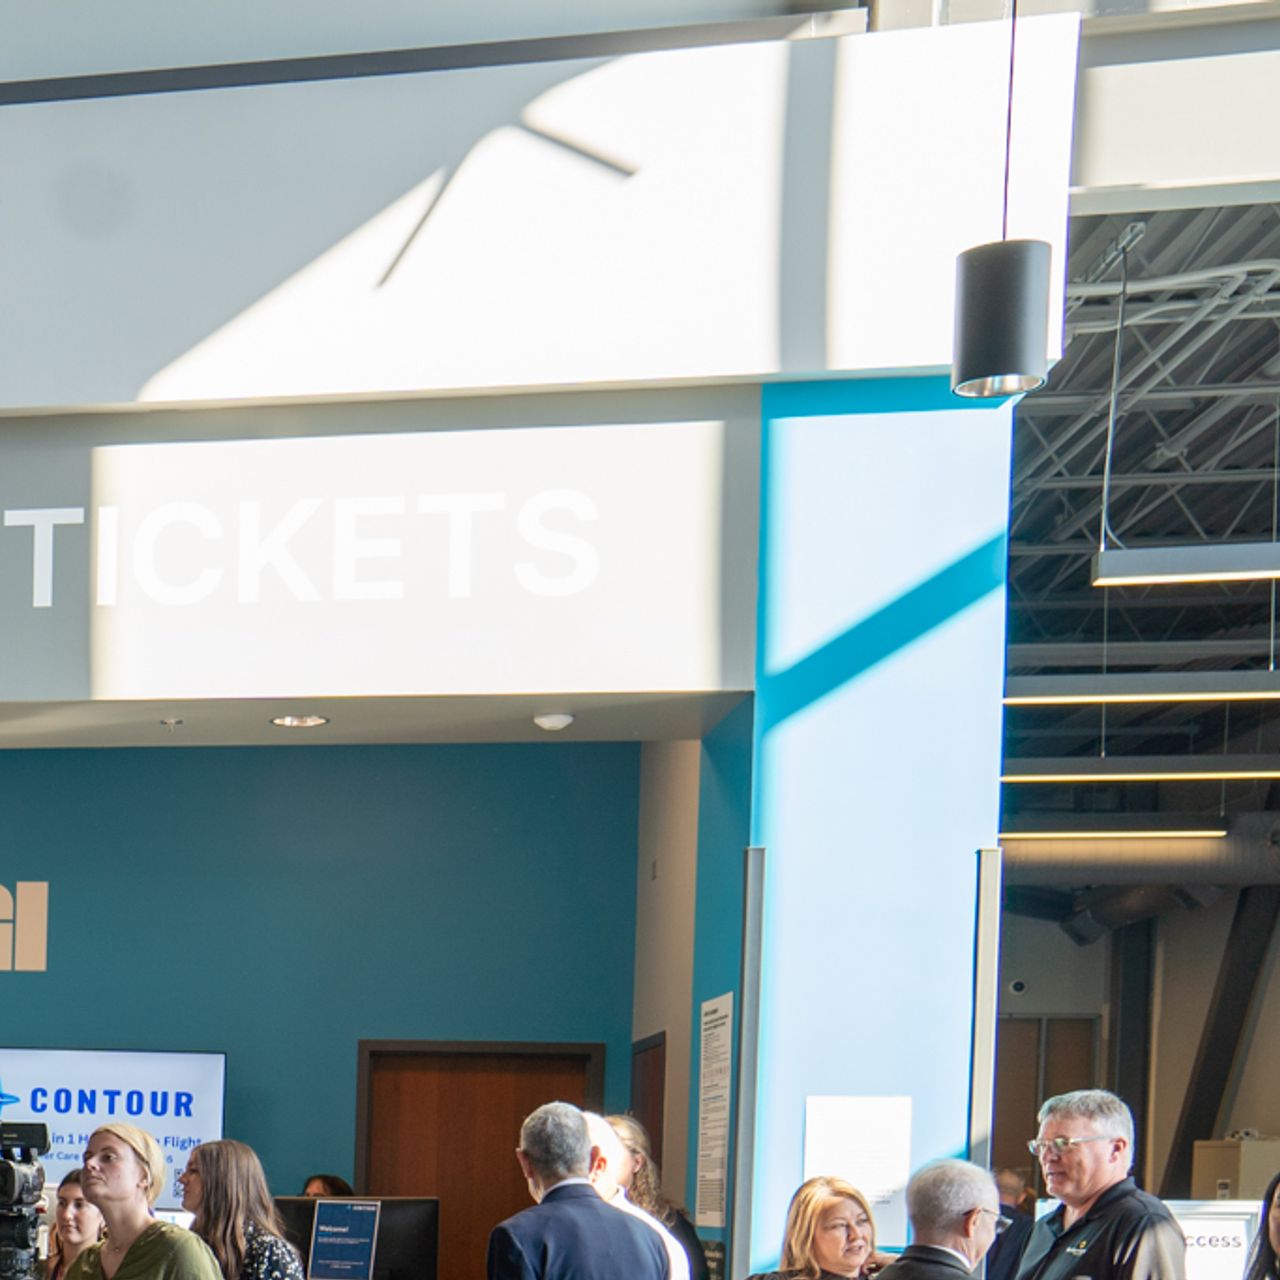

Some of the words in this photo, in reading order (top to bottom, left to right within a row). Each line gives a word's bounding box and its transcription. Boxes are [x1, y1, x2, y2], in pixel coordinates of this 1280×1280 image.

[3, 489, 600, 608] TICKETS
[30, 1087, 193, 1117] CONTOUR
[52, 1132, 64, 1143] in
[68, 1133, 74, 1144] 1
[1184, 1235, 1242, 1248] ccess
